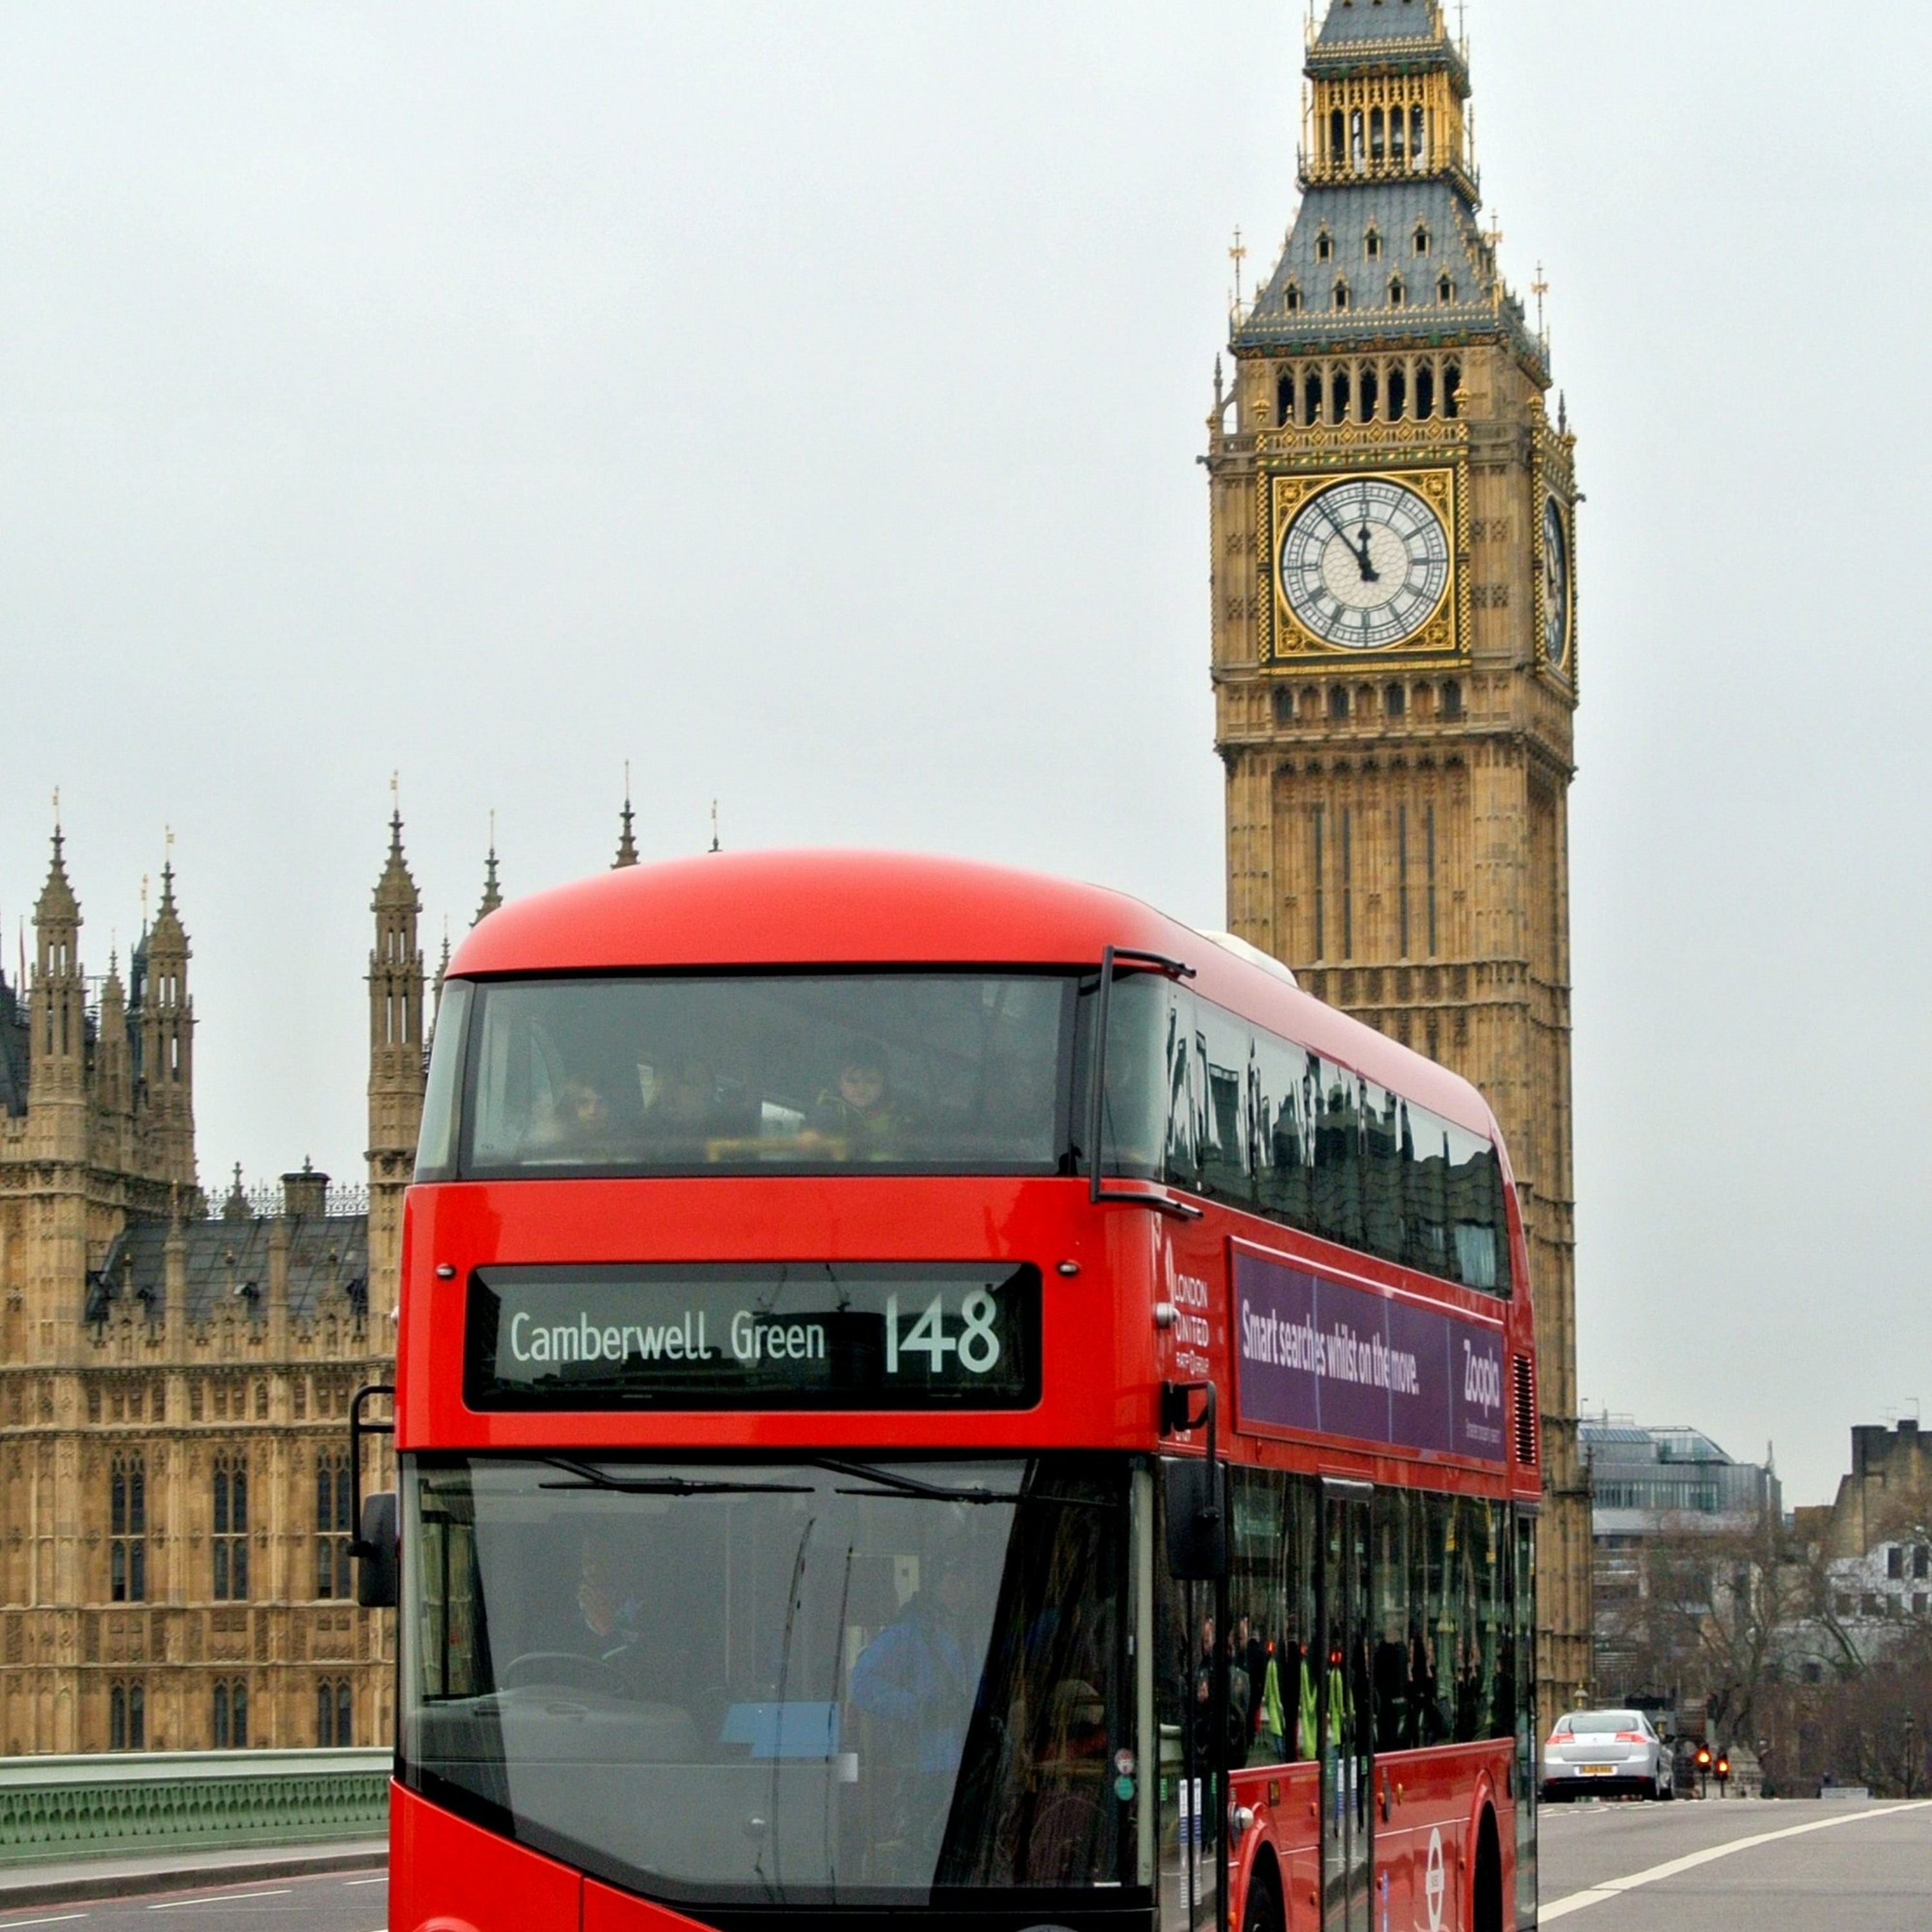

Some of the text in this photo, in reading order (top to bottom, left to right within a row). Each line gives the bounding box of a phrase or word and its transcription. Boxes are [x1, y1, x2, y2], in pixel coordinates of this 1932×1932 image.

[1174, 1274, 1208, 1308] LONDON
[1175, 1314, 1209, 1347] UNITED
[511, 1291, 1000, 1373] Camberwell Green 148
[1242, 1298, 1419, 1395] Smart searches whilst on the move.
[1463, 1339, 1500, 1418] Zoopla
